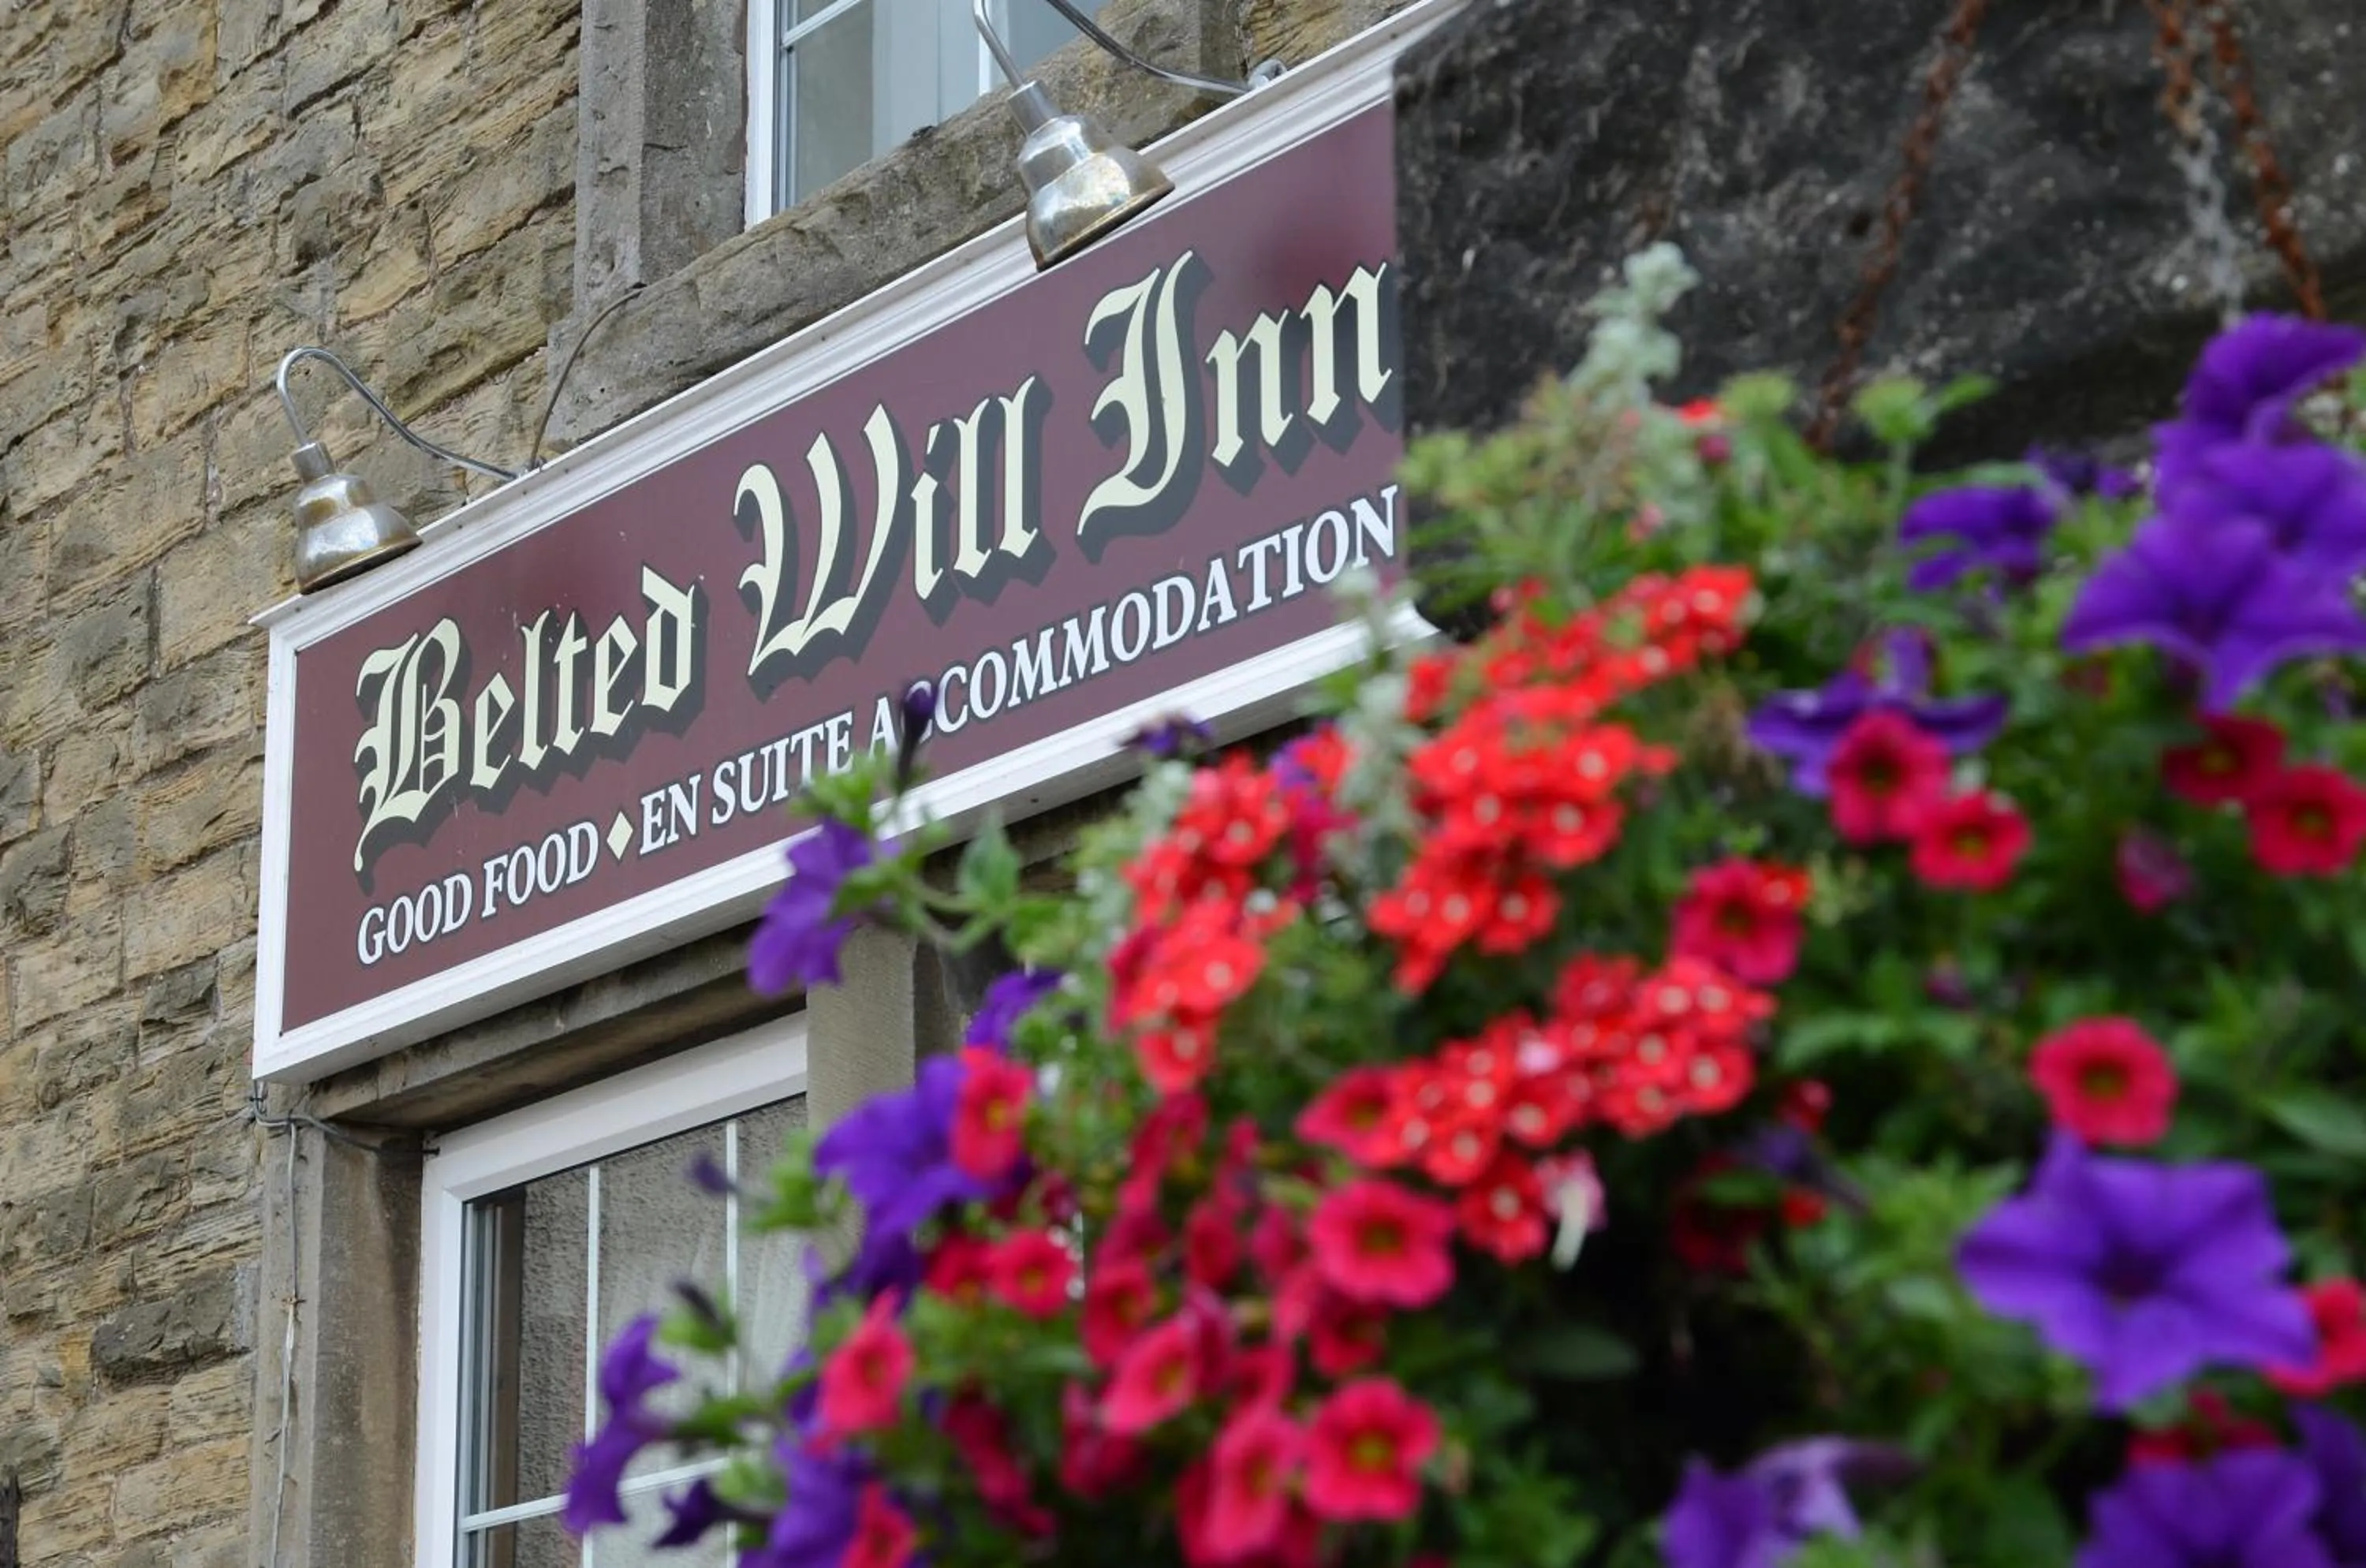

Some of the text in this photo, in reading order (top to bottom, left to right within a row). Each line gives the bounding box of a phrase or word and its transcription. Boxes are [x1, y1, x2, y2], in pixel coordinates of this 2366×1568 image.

[354, 251, 1392, 872] Belted Will Inn
[357, 872, 472, 965] GOOD
[481, 821, 599, 917] FOOD
[640, 774, 701, 855] EN
[711, 711, 854, 825] SUITE
